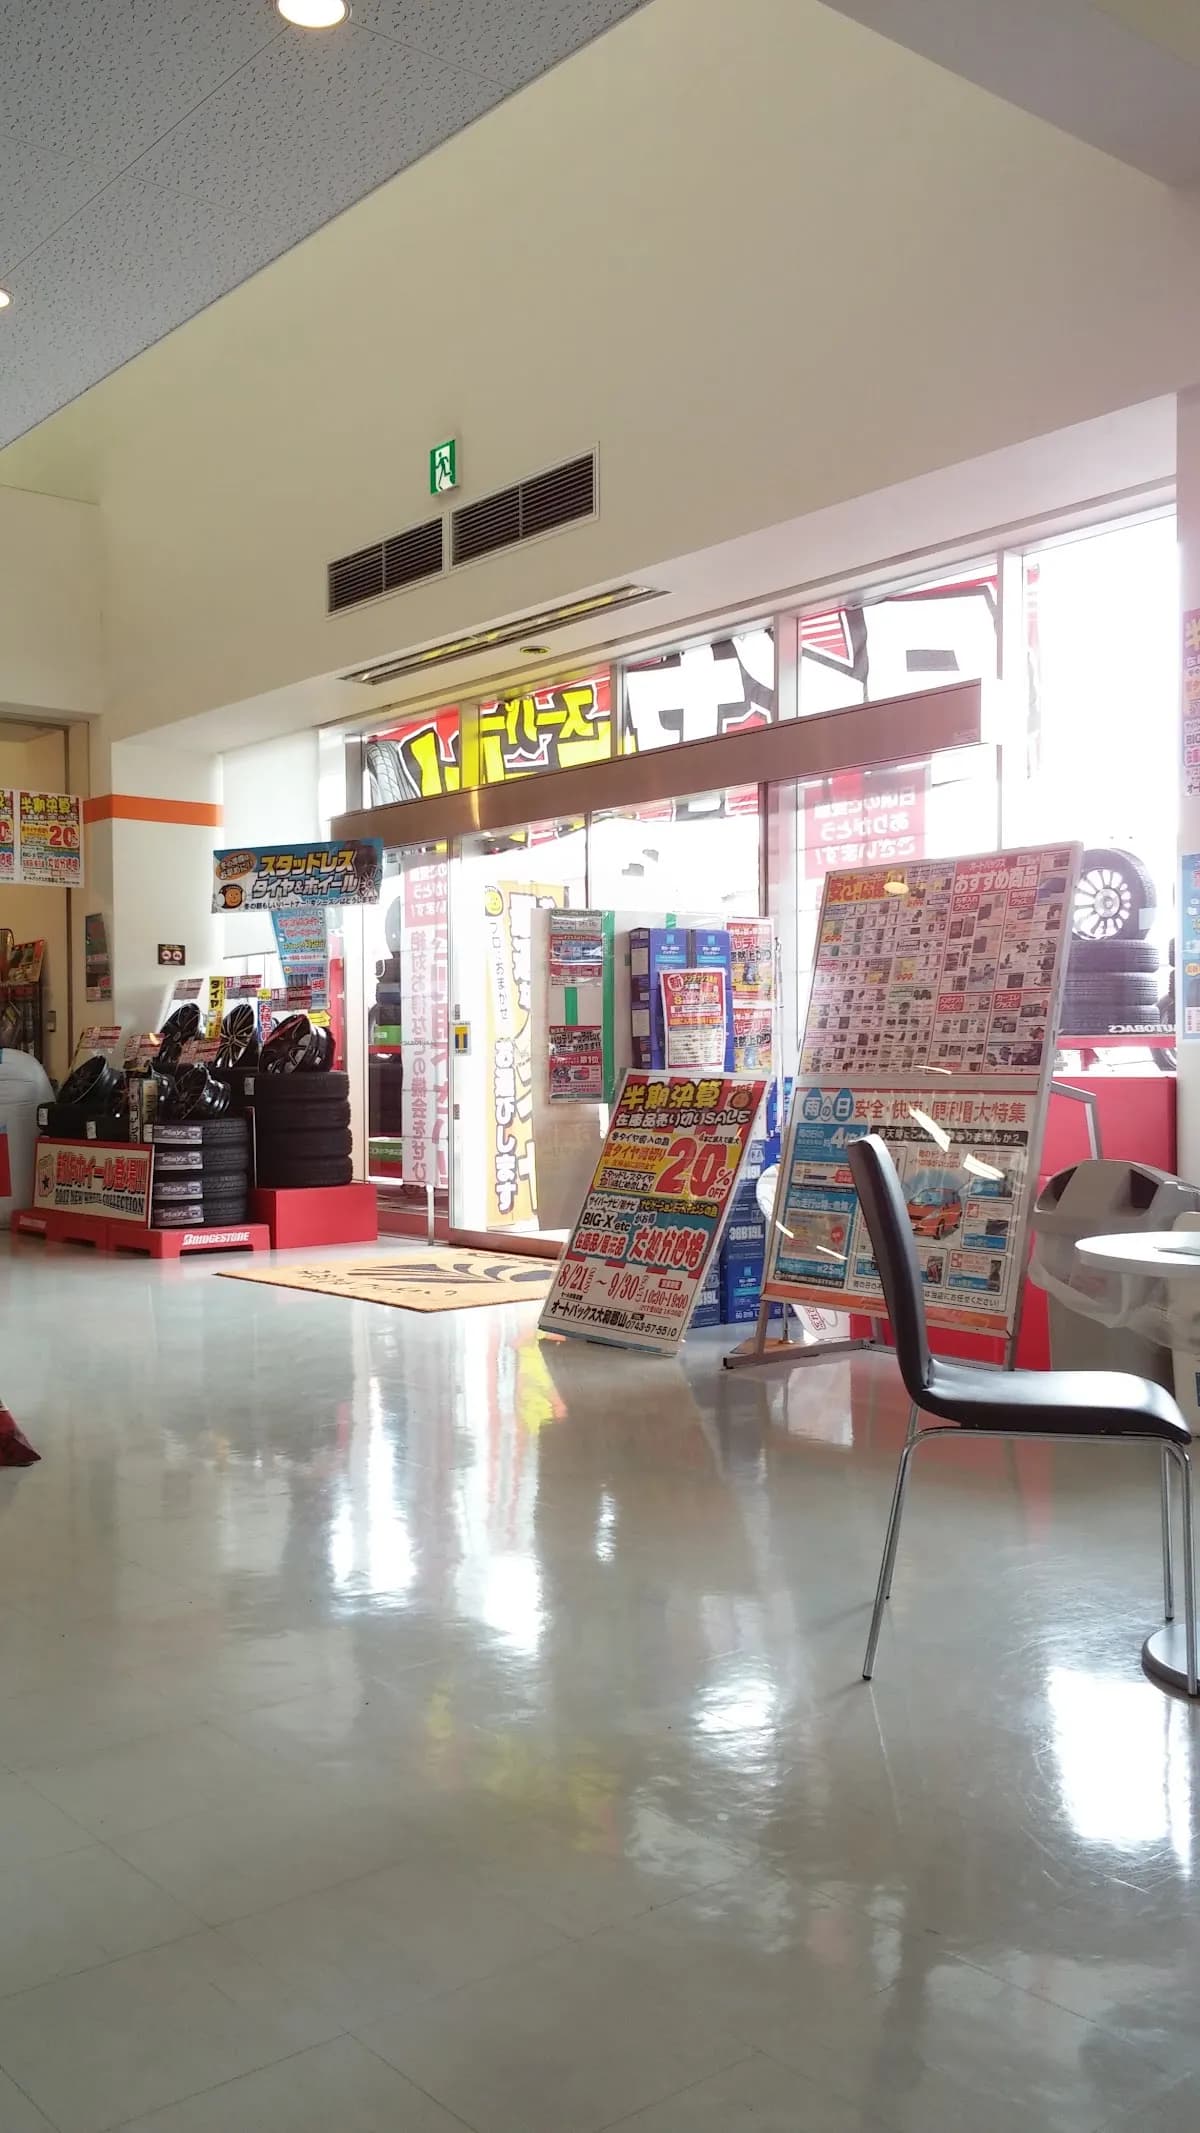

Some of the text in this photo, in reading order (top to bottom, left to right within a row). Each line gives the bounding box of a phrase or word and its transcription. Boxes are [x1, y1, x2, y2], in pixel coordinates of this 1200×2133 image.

[259, 851, 356, 878] スタッドレス
[252, 875, 358, 899] タイヤ&ホイール
[955, 865, 1037, 893] おすすめ商品
[210, 980, 219, 1008] タイヤ
[620, 1080, 722, 1111] 半期決算
[804, 1096, 850, 1119] 雨の日
[655, 1137, 727, 1197] 20
[708, 1188, 725, 1199] OFF
[102, 1194, 144, 1213] COLLECTION
[583, 1209, 630, 1231] BIG-X etc
[729, 1225, 764, 1240] 38B19L
[182, 1231, 250, 1246] BRIDGESTONE
[558, 1263, 588, 1291] 8/21
[608, 1271, 639, 1300] 9/30
[551, 1300, 627, 1327] オートバックス大和郡山
[626, 1318, 678, 1336] 0743-57-5510
